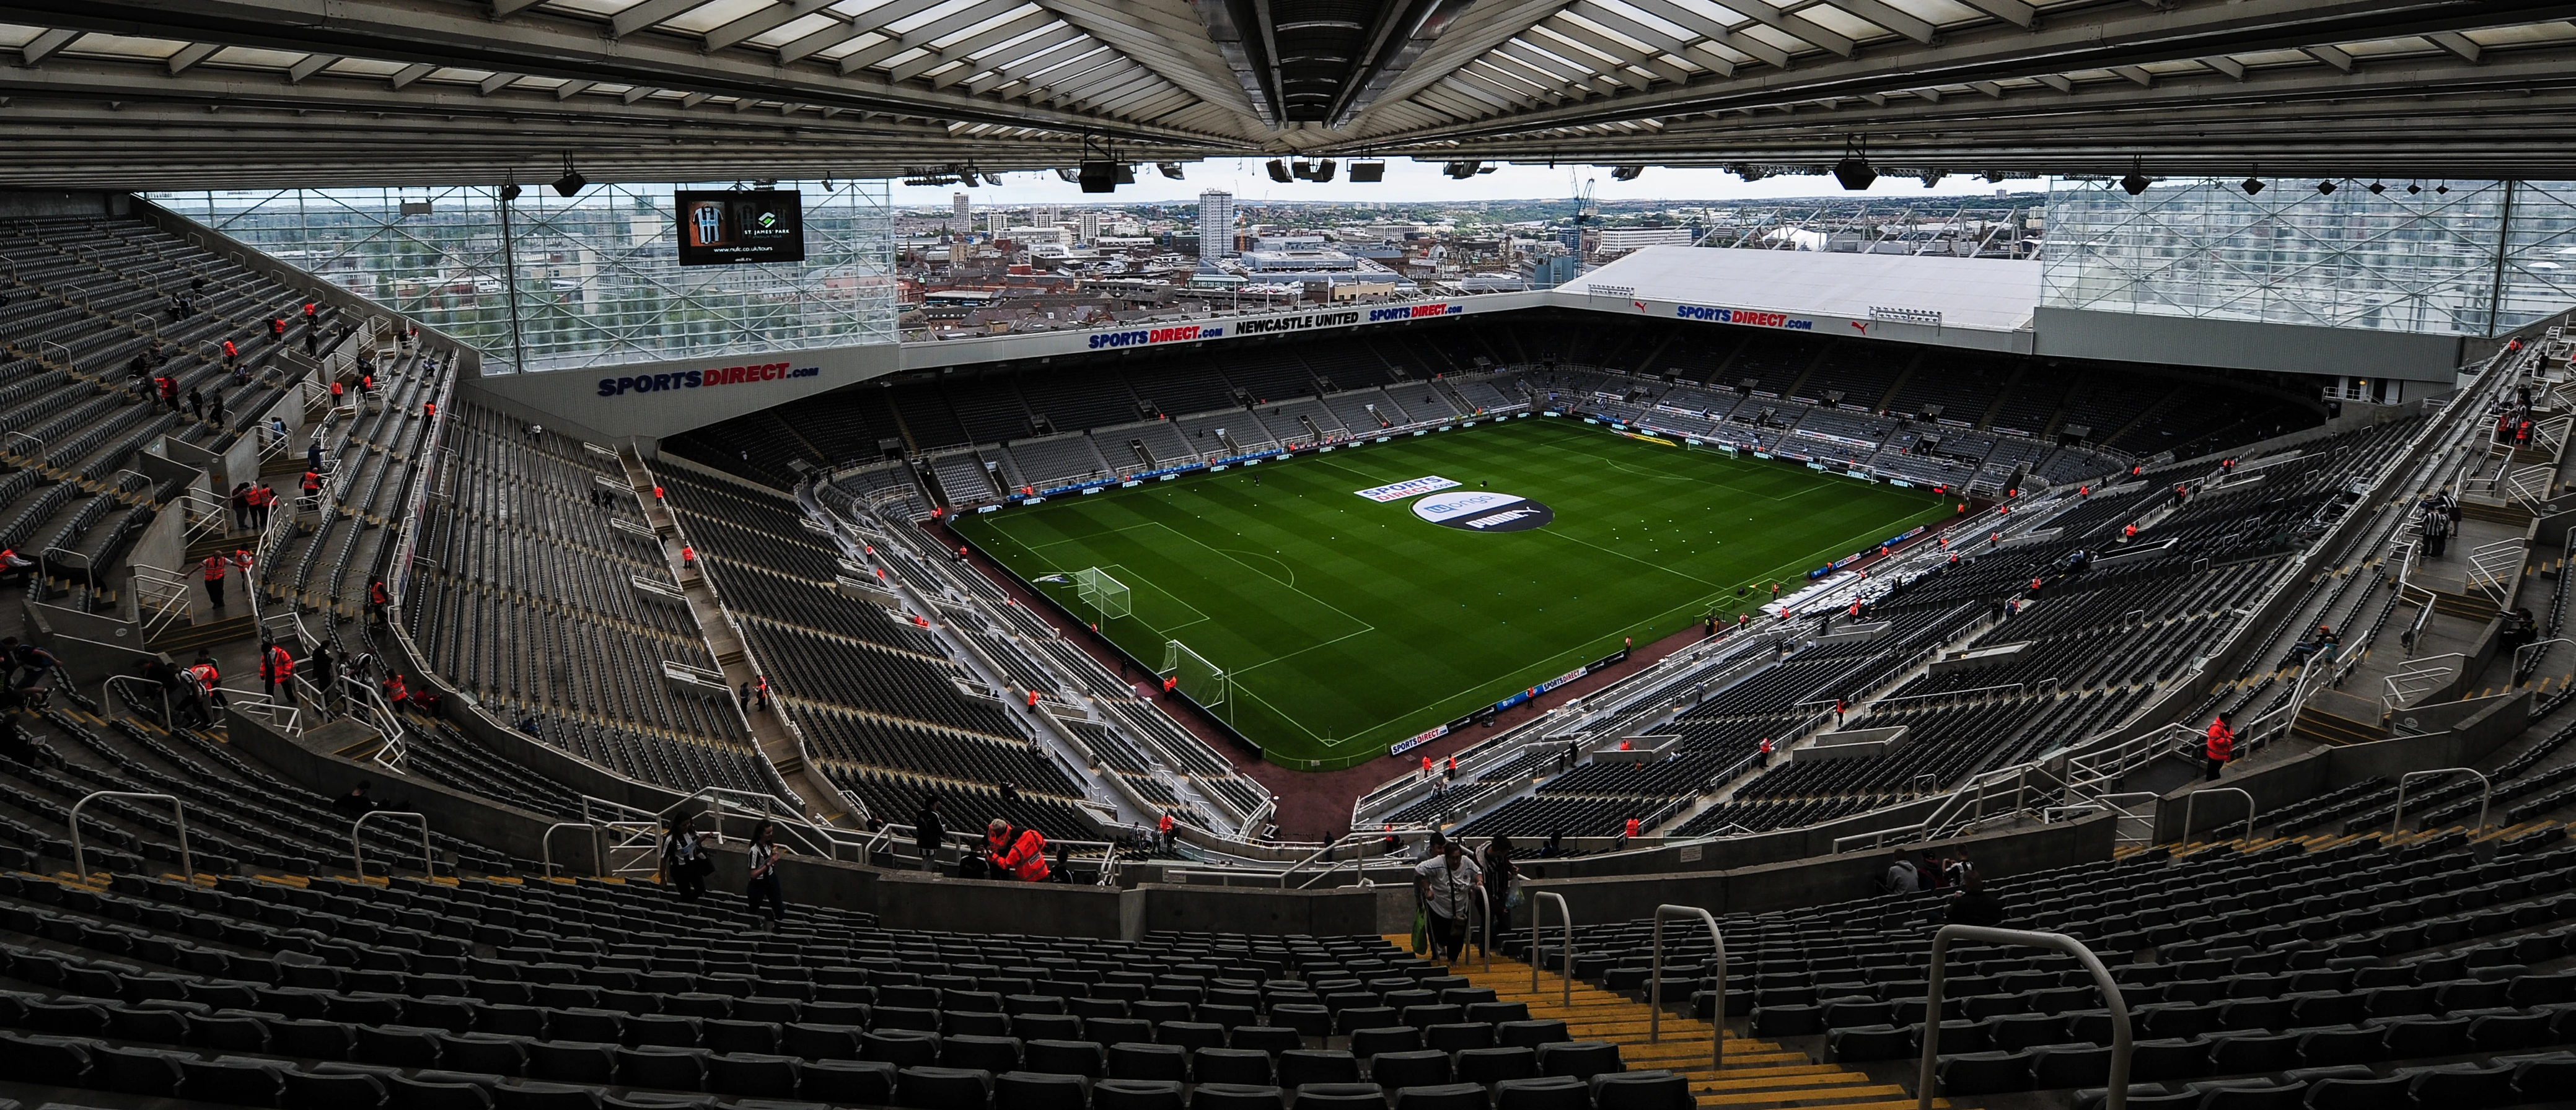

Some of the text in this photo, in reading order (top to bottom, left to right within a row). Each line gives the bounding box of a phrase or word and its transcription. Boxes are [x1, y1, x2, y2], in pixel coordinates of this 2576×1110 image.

[1236, 312, 1359, 334] NEWCASTLE UNITED
[1847, 470, 1864, 479] PUMA
[1363, 477, 1443, 496] SPORTS
[1890, 479, 1908, 487] PUMA
[1083, 487, 1099, 495] PUMA
[1023, 497, 1040, 505] PUMA
[1423, 495, 1495, 513] wonga
[978, 505, 996, 513] PUMA
[1466, 510, 1529, 530] PUMA
